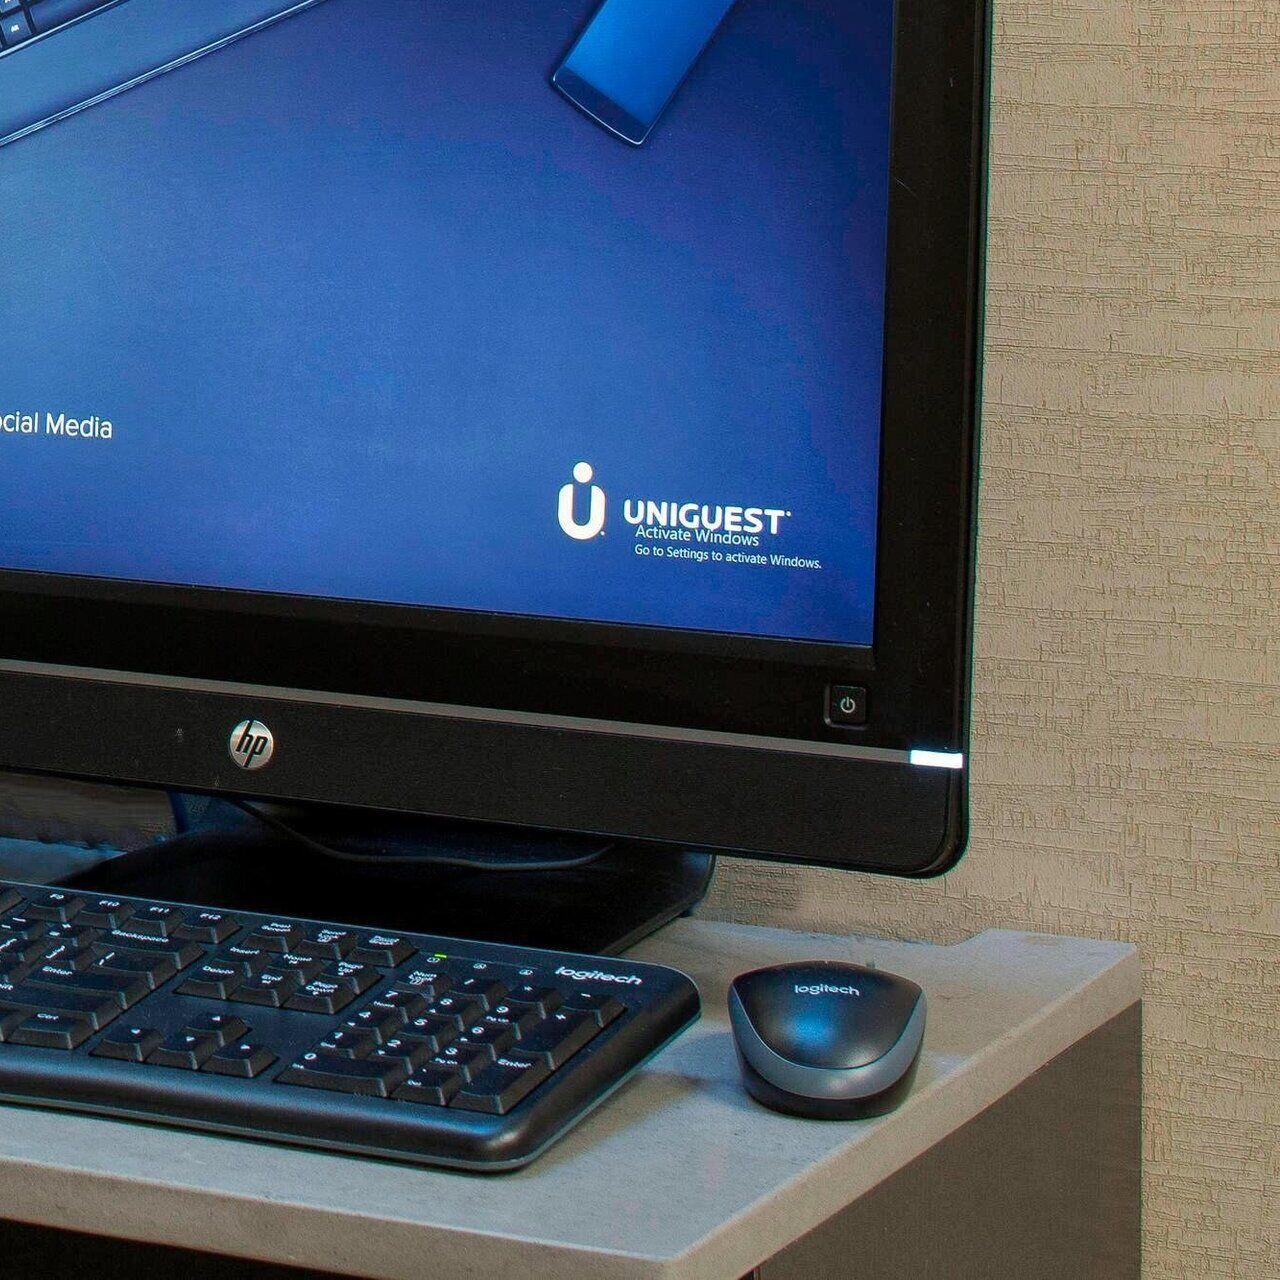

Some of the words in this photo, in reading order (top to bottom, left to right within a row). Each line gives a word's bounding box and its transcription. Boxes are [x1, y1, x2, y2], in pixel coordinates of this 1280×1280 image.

[45, 413, 113, 439] Media
[623, 499, 787, 535] UNIGUEST
[635, 525, 691, 542] Activate
[695, 529, 760, 547] Windows
[634, 544, 651, 556] Go
[652, 545, 664, 557] to
[666, 547, 709, 563] Settings
[711, 550, 723, 562] to
[725, 550, 767, 565] activate
[770, 554, 823, 569] Windows.
[233, 720, 271, 768] hp
[555, 966, 642, 986] logitech
[794, 982, 860, 997] logitech
